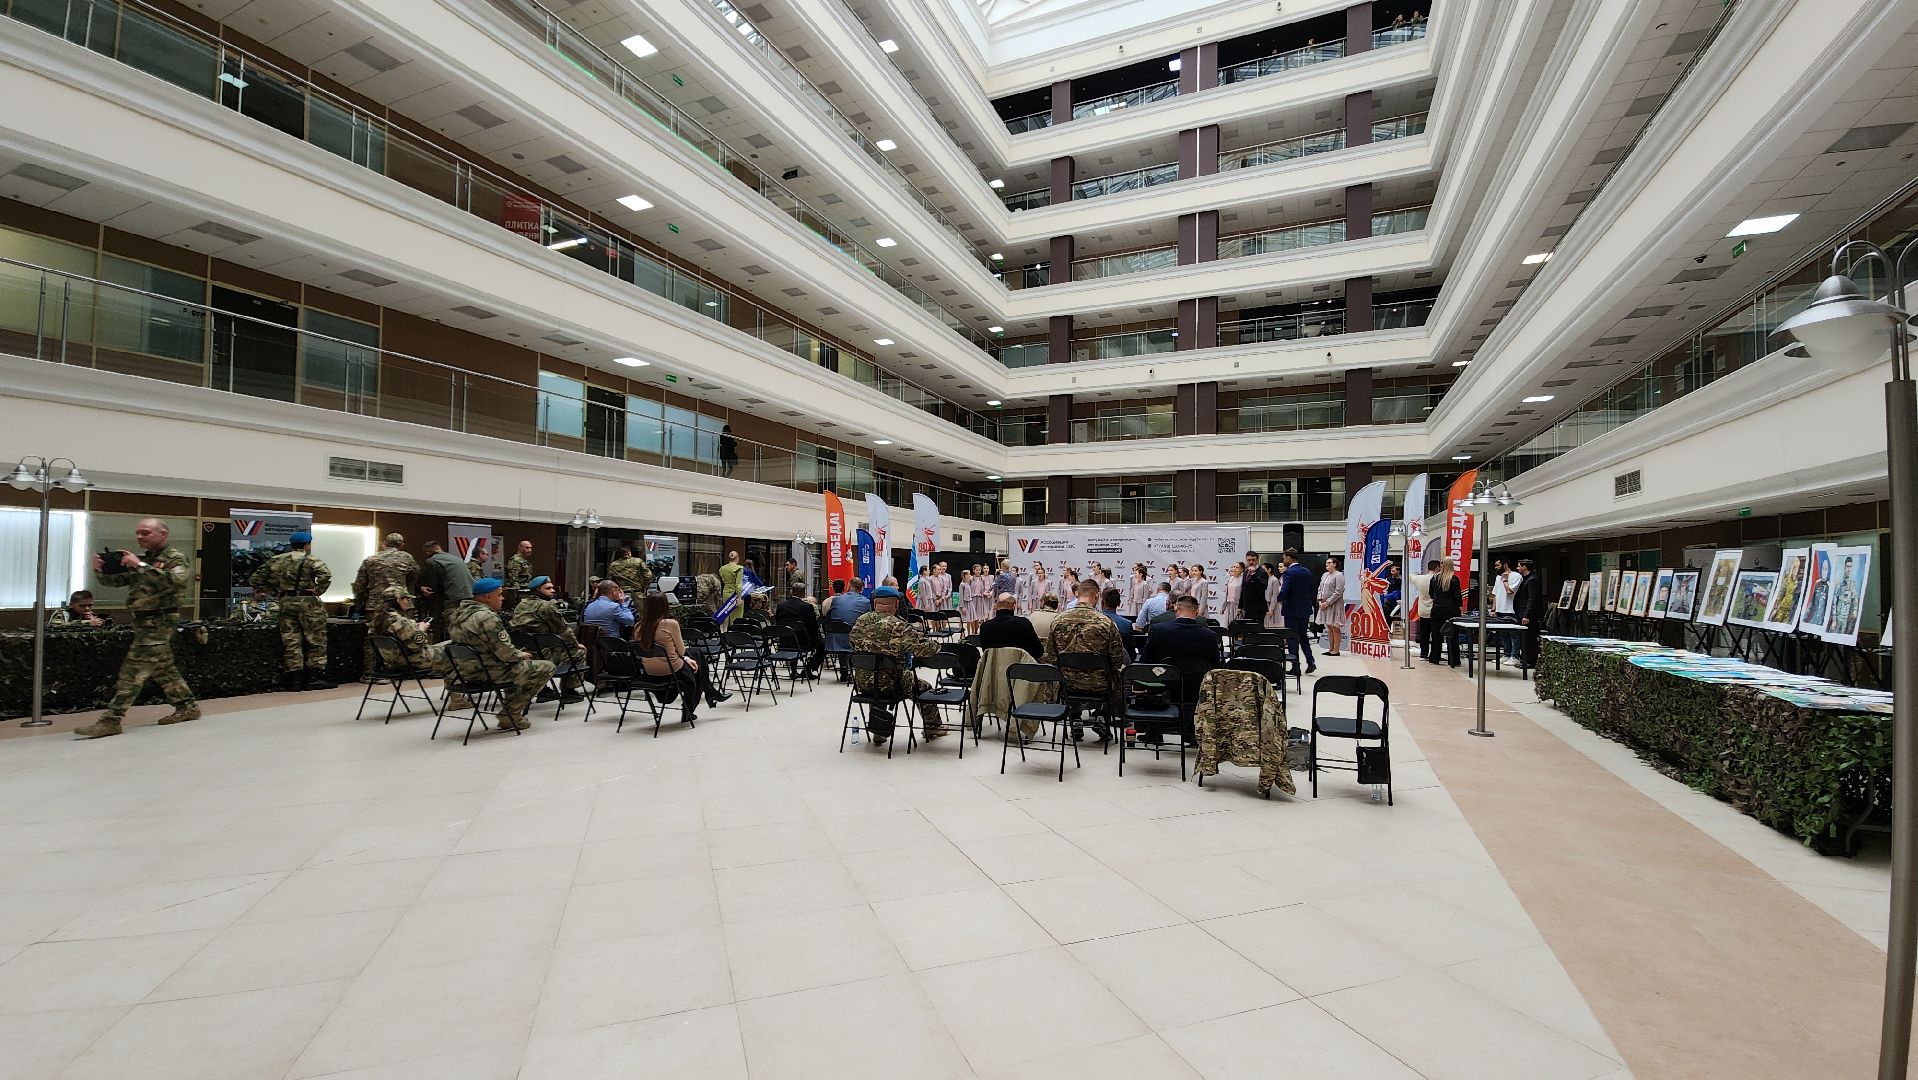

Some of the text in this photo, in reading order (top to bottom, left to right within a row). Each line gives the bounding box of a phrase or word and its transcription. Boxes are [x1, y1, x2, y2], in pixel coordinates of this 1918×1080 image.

[505, 220, 539, 230] ПЛИТКА
[830, 512, 842, 566] ПОБЕДА!
[1350, 541, 1364, 553] 80
[1350, 612, 1372, 638] 80
[1350, 640, 1391, 659] ПОБЕДА!
